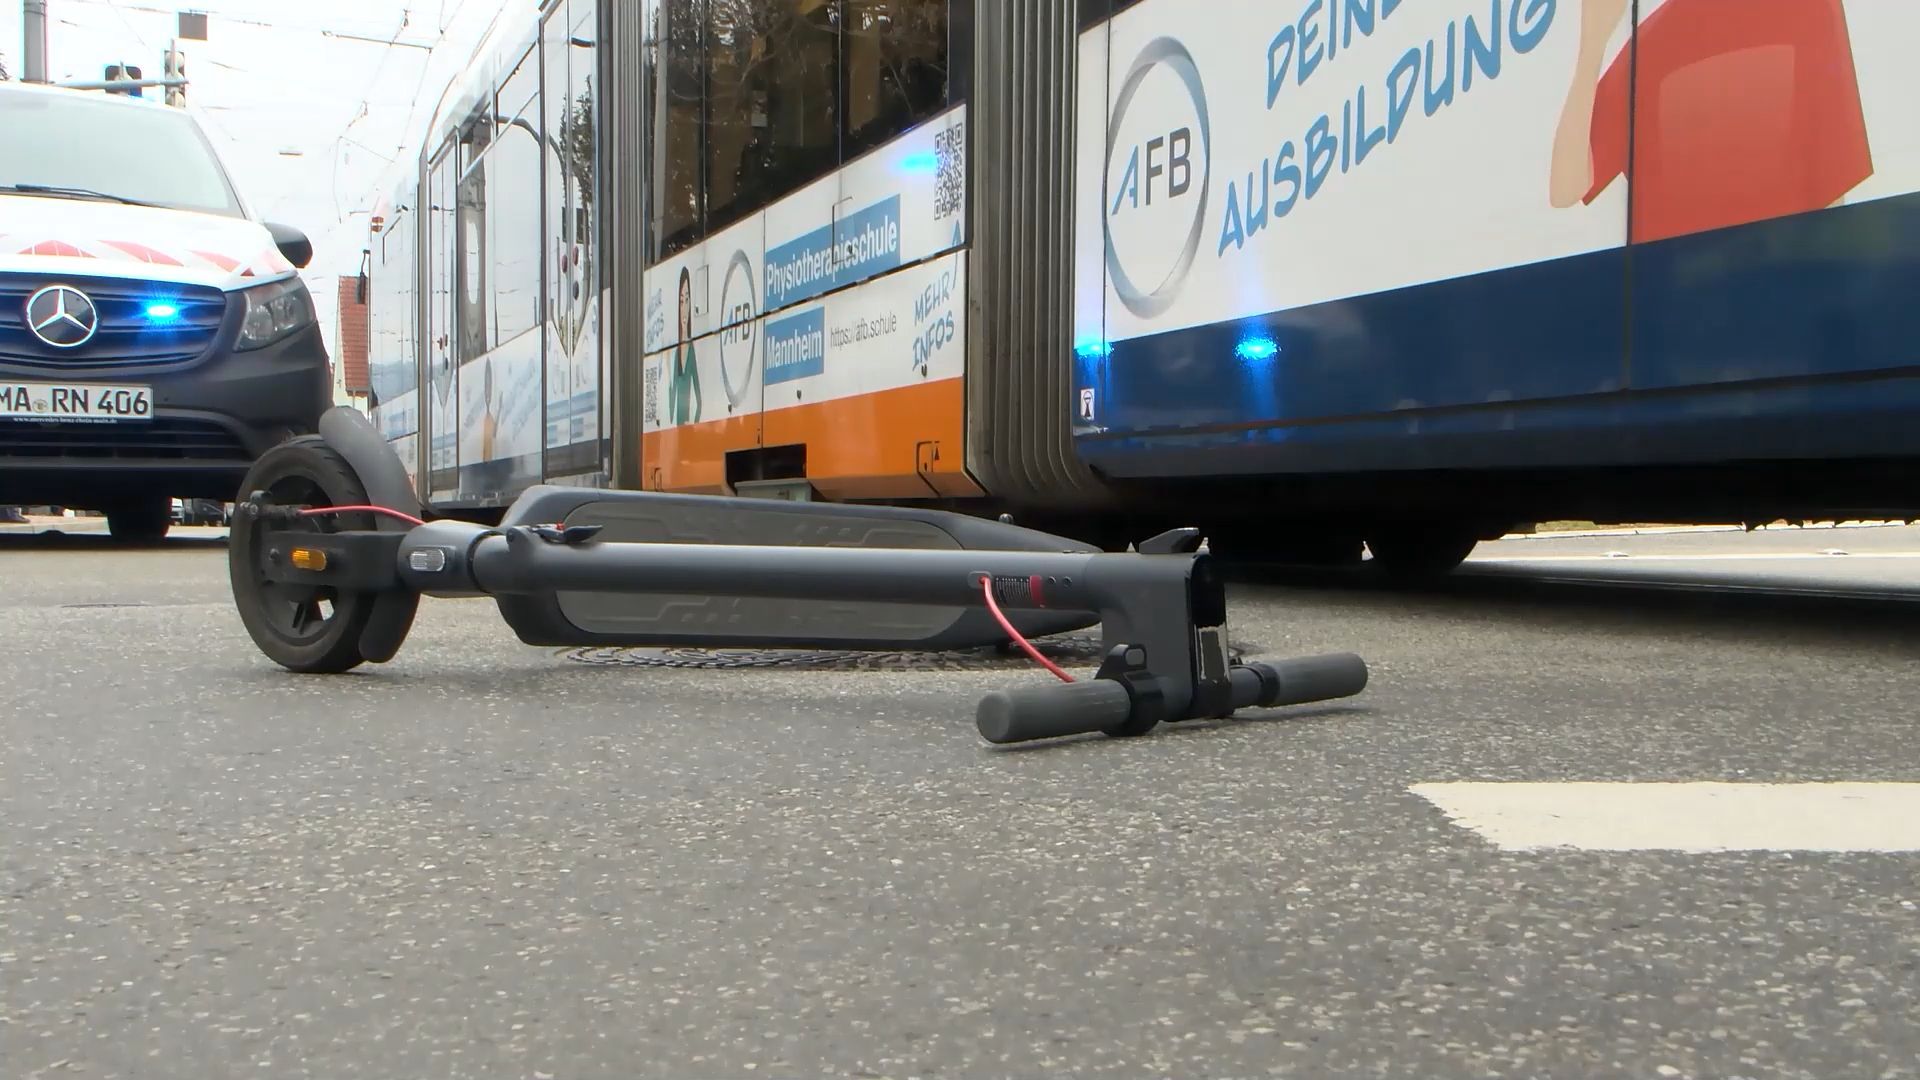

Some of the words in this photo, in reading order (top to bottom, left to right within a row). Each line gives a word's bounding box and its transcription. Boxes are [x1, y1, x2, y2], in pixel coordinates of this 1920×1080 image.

[1267, 0, 1402, 110] DEIN
[1218, 0, 1557, 258] AUSBILDUNG
[1112, 127, 1192, 216] AFB
[766, 215, 898, 301] Physiotherapieschule
[723, 302, 751, 346] AFB
[914, 271, 951, 327] MEHR
[766, 324, 823, 370] Mannheim
[830, 311, 898, 351] https://afb.schule
[912, 310, 955, 372] INFOS
[52, 388, 89, 413] RN
[97, 390, 149, 415] 406
